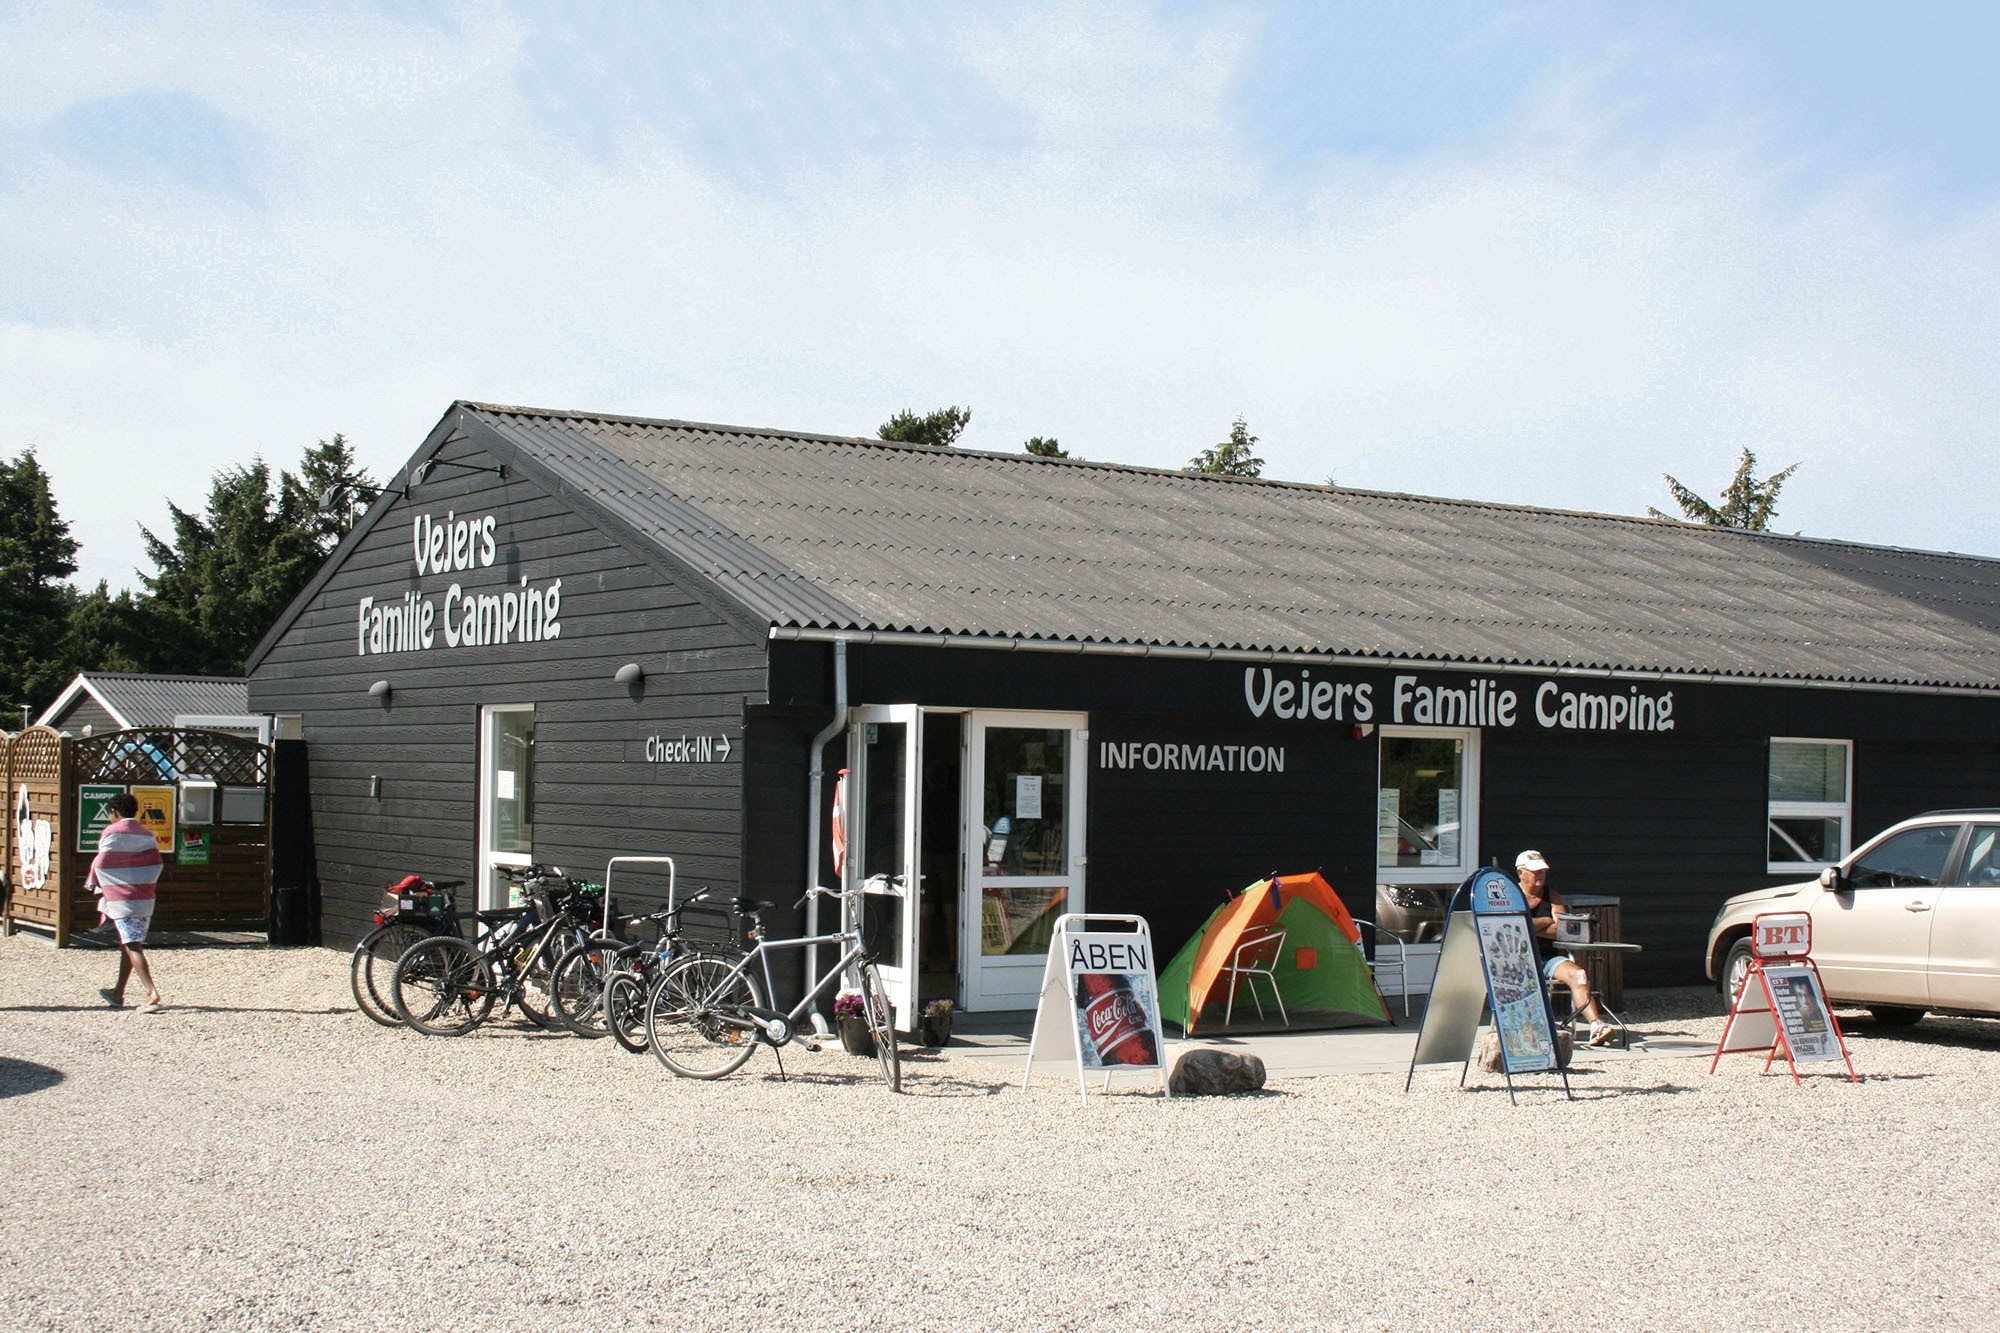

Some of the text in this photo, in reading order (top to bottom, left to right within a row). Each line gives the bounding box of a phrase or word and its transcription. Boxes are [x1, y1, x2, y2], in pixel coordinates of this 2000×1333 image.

[413, 510, 497, 577] Vejers
[358, 575, 562, 656] Familie Camping
[1244, 667, 1675, 731] Vejers Familie Camping
[645, 734, 713, 763] Check-IN
[1100, 742, 1285, 773] INFORMATION
[1071, 938, 1147, 970] ÅBEN
[1092, 995, 1137, 1034] Coca-Cola
